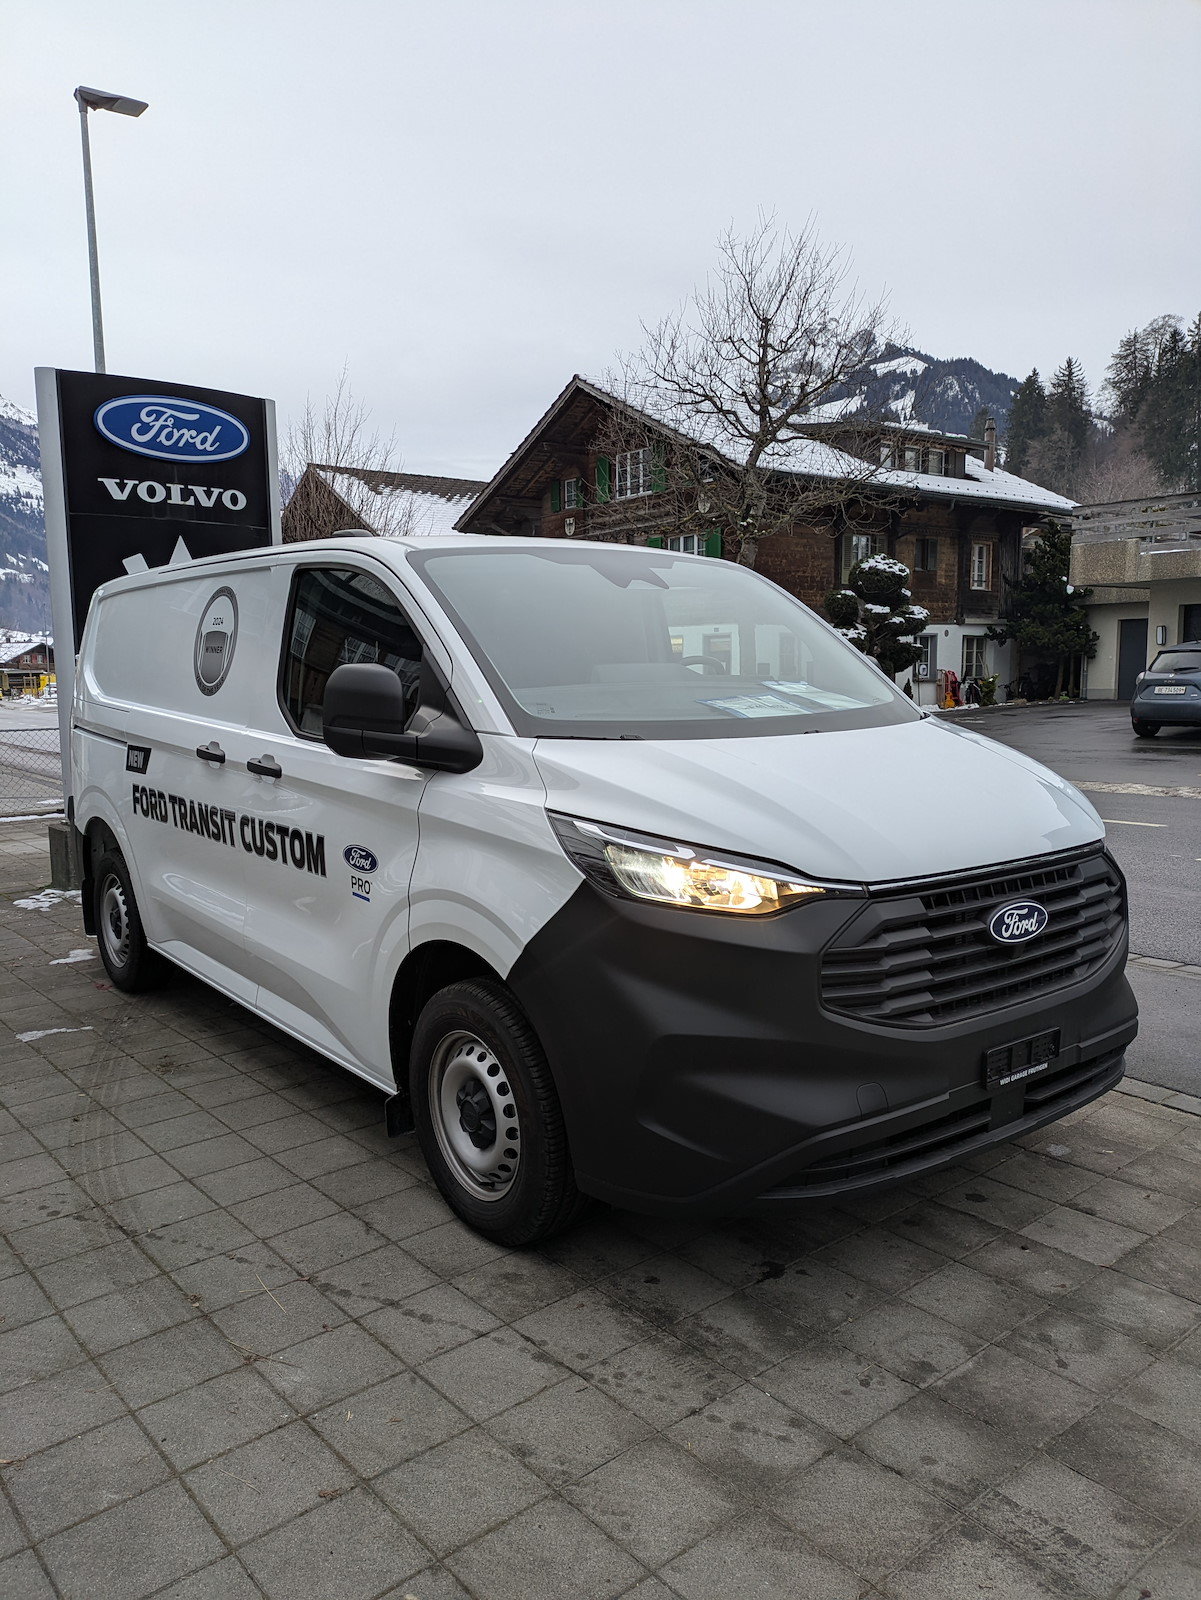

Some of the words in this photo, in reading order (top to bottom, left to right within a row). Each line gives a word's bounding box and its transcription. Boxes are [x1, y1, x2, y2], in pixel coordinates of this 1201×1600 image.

[131, 405, 222, 452] Ford
[97, 477, 247, 511] VOLVO
[212, 617, 224, 626] 2024
[205, 645, 223, 654] WINNER
[127, 749, 145, 769] NEW
[132, 783, 169, 824] FORD
[168, 794, 236, 848] TRANSIT
[239, 814, 328, 879] CUSTOM
[349, 847, 372, 870] Ford
[350, 875, 371, 895] PRO
[1001, 907, 1039, 938] Ford
[1011, 1070, 1028, 1081] GARAGE
